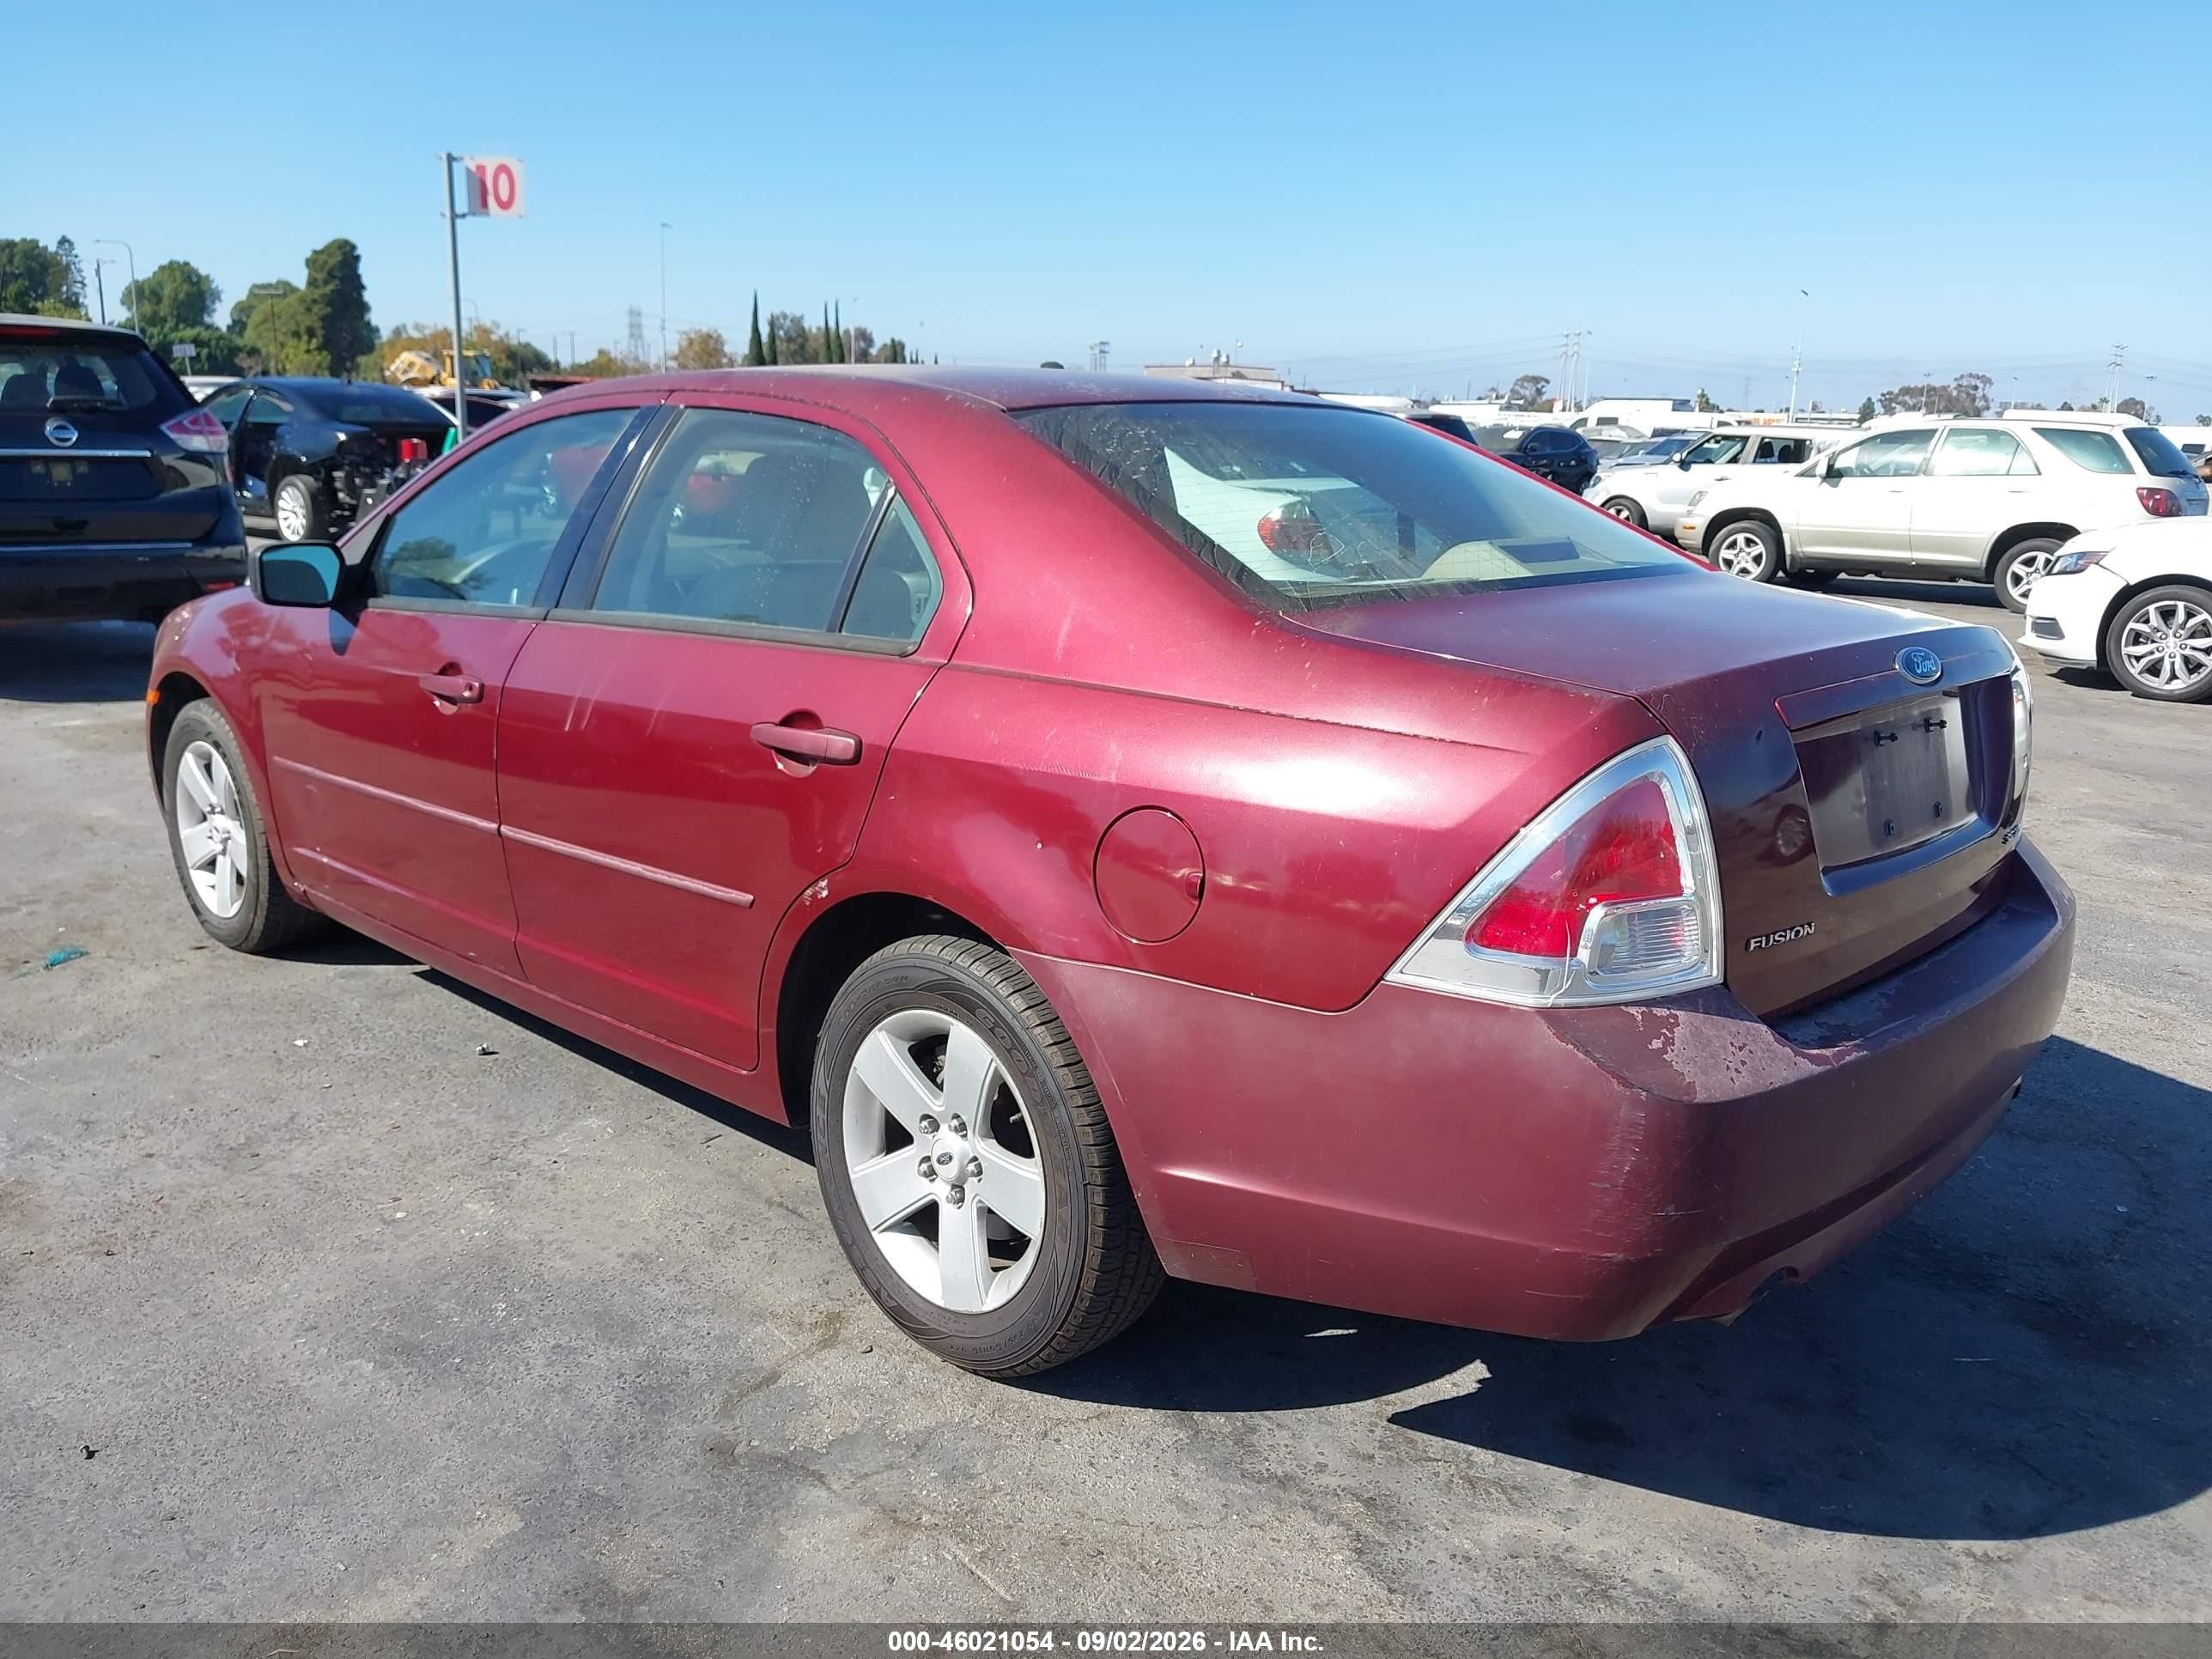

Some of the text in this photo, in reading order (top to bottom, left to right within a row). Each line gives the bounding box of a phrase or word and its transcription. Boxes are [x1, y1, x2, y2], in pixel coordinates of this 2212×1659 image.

[475, 164, 515, 210] 10
[1911, 652, 1937, 674] Ford
[1748, 922, 1815, 951] FUSION
